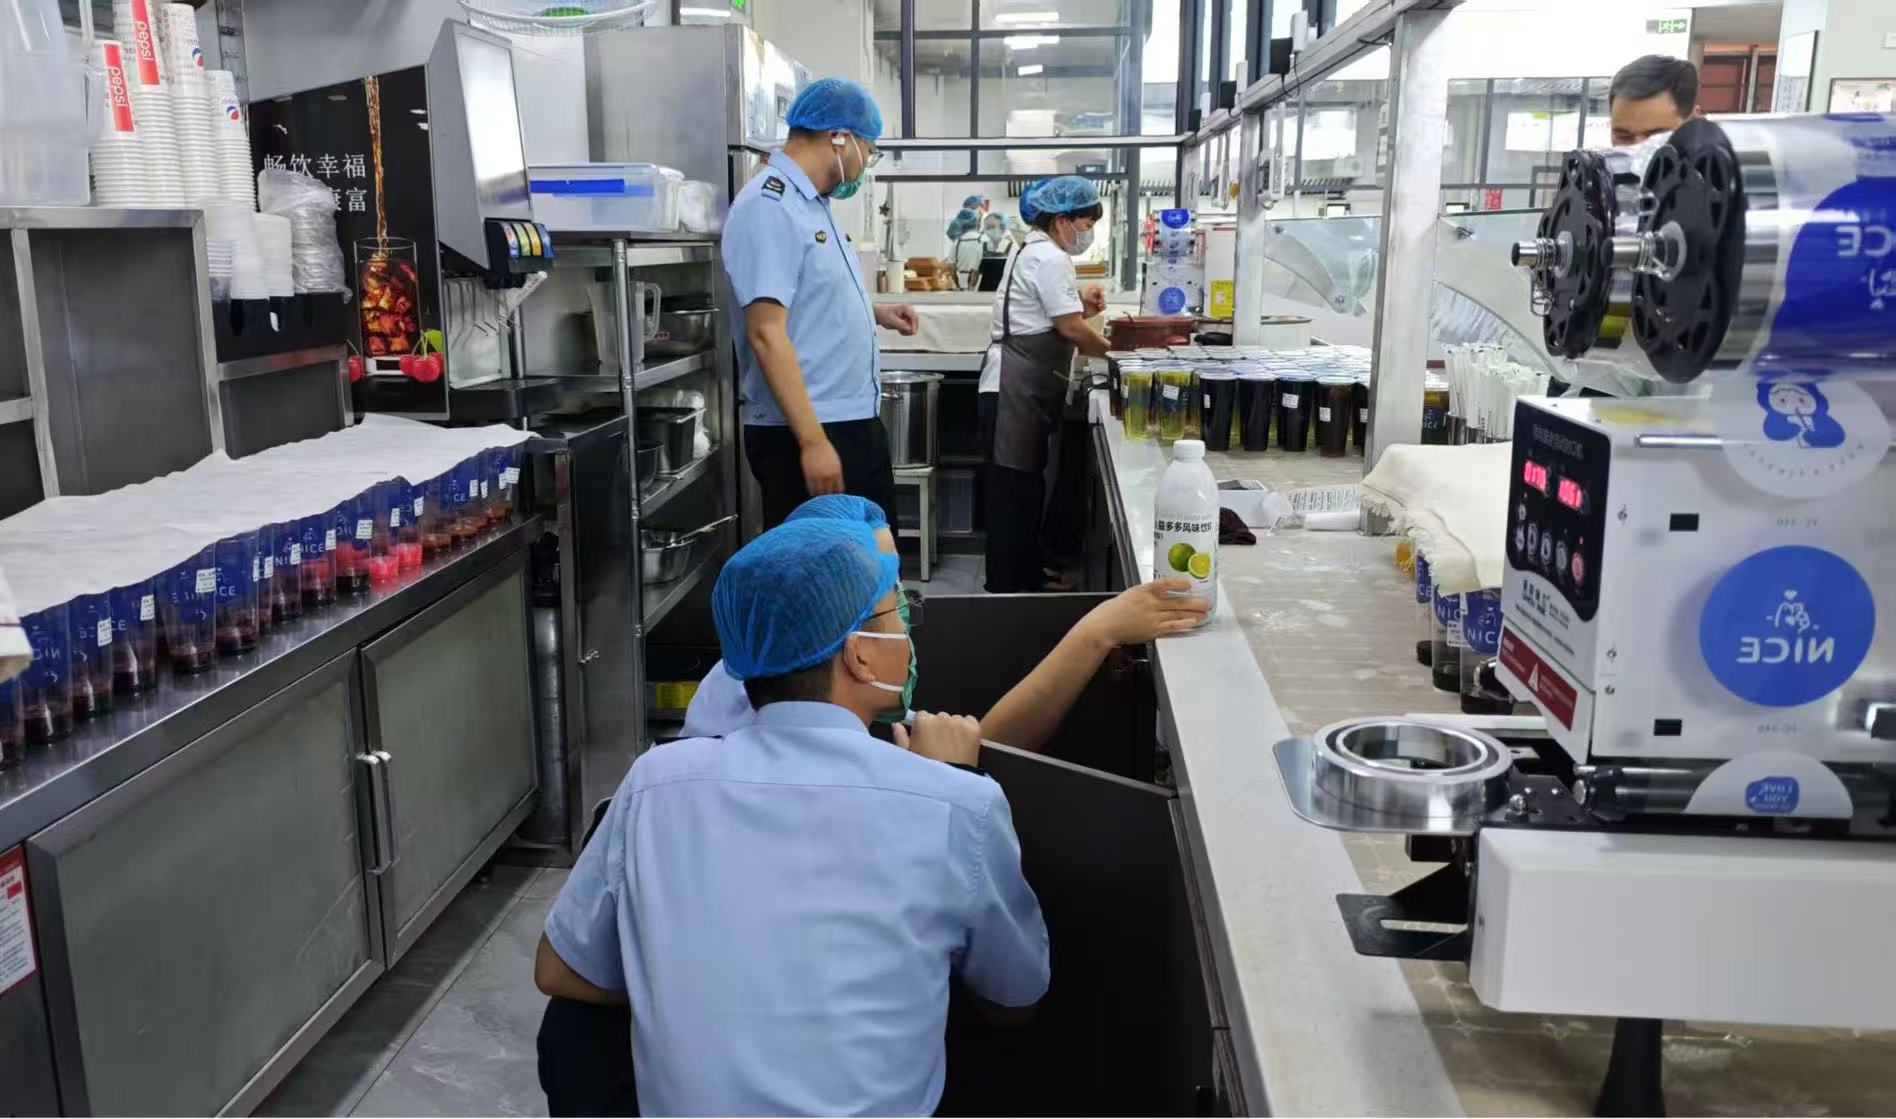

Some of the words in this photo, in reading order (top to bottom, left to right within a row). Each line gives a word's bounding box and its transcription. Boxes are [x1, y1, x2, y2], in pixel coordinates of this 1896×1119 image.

[134, 20, 154, 62] pepsi
[107, 66, 129, 108] pepsi
[263, 153, 367, 179] 畅饮幸福
[1467, 627, 1499, 644] NIC
